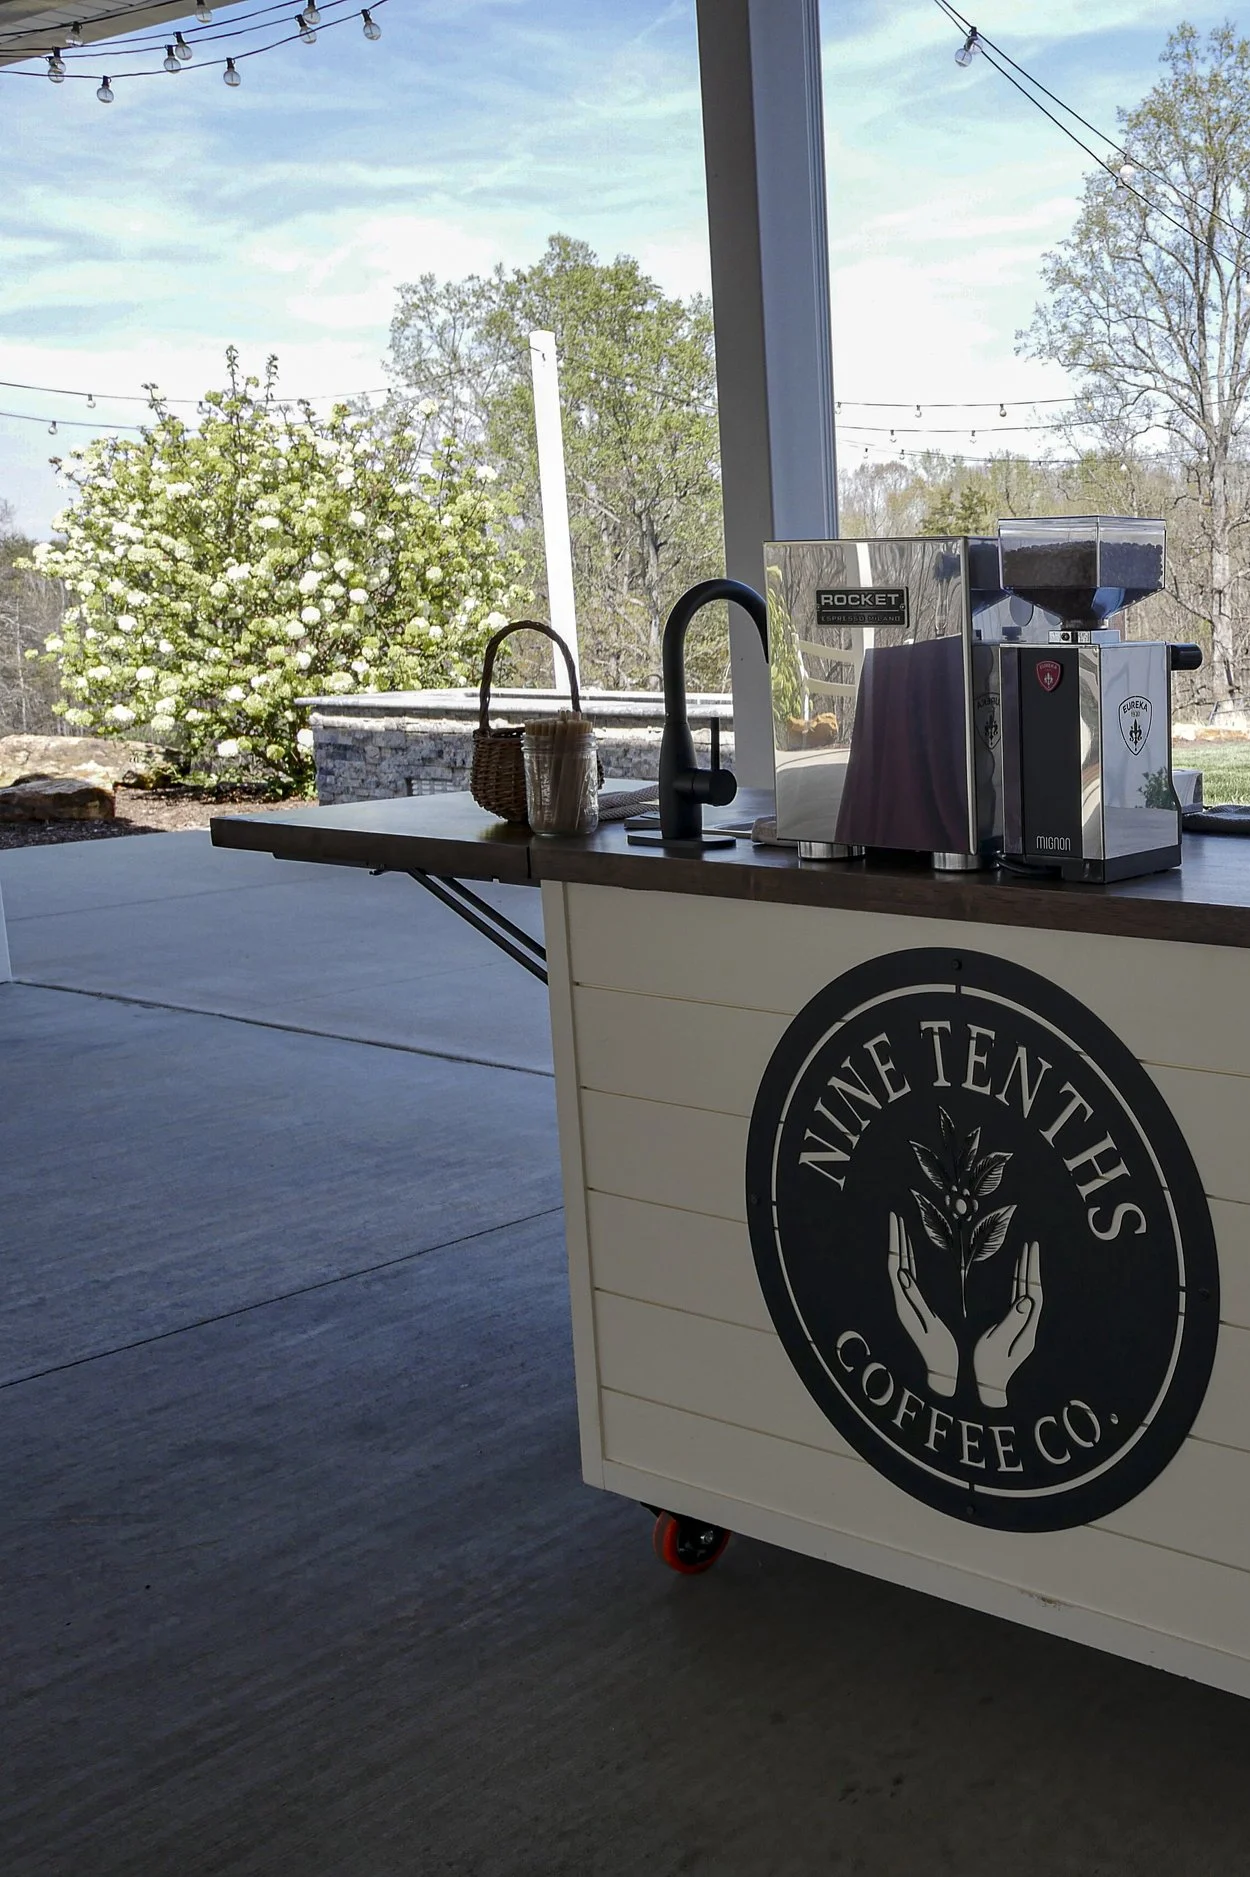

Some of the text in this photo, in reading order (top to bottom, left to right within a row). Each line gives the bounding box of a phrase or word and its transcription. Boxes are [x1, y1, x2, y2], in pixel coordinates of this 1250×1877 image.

[820, 594, 900, 606] ROCKET
[821, 615, 901, 623] ESPRESSO MILANO
[1122, 700, 1148, 714] EUREKA
[798, 1019, 1148, 1241] NINE TENTHS
[834, 1329, 1120, 1473] COFFEE CO.
